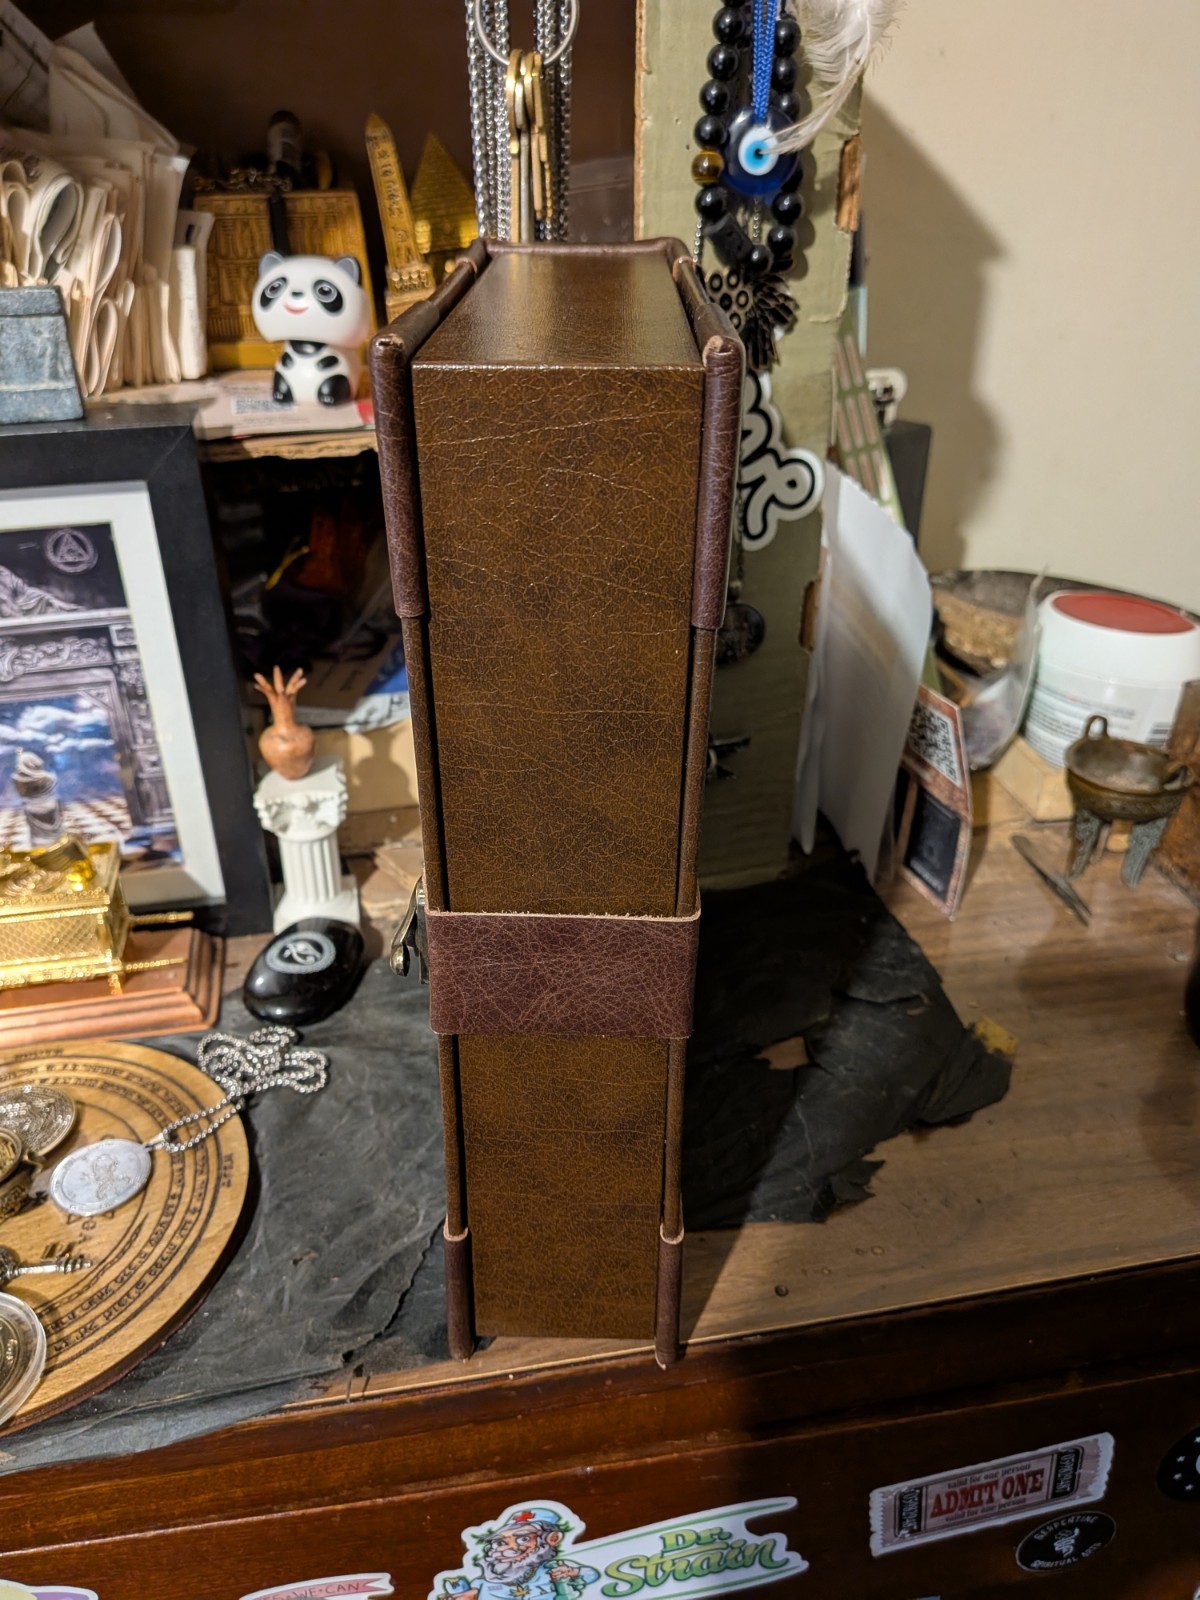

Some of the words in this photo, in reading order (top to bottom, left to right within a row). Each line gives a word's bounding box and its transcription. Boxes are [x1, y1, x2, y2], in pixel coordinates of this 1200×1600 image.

[930, 1479, 999, 1519] ADMIT
[1001, 1467, 1045, 1500] ONE
[659, 1526, 732, 1551] Dr.
[601, 1539, 789, 1597] Strain
[324, 1582, 360, 1594] CAN
